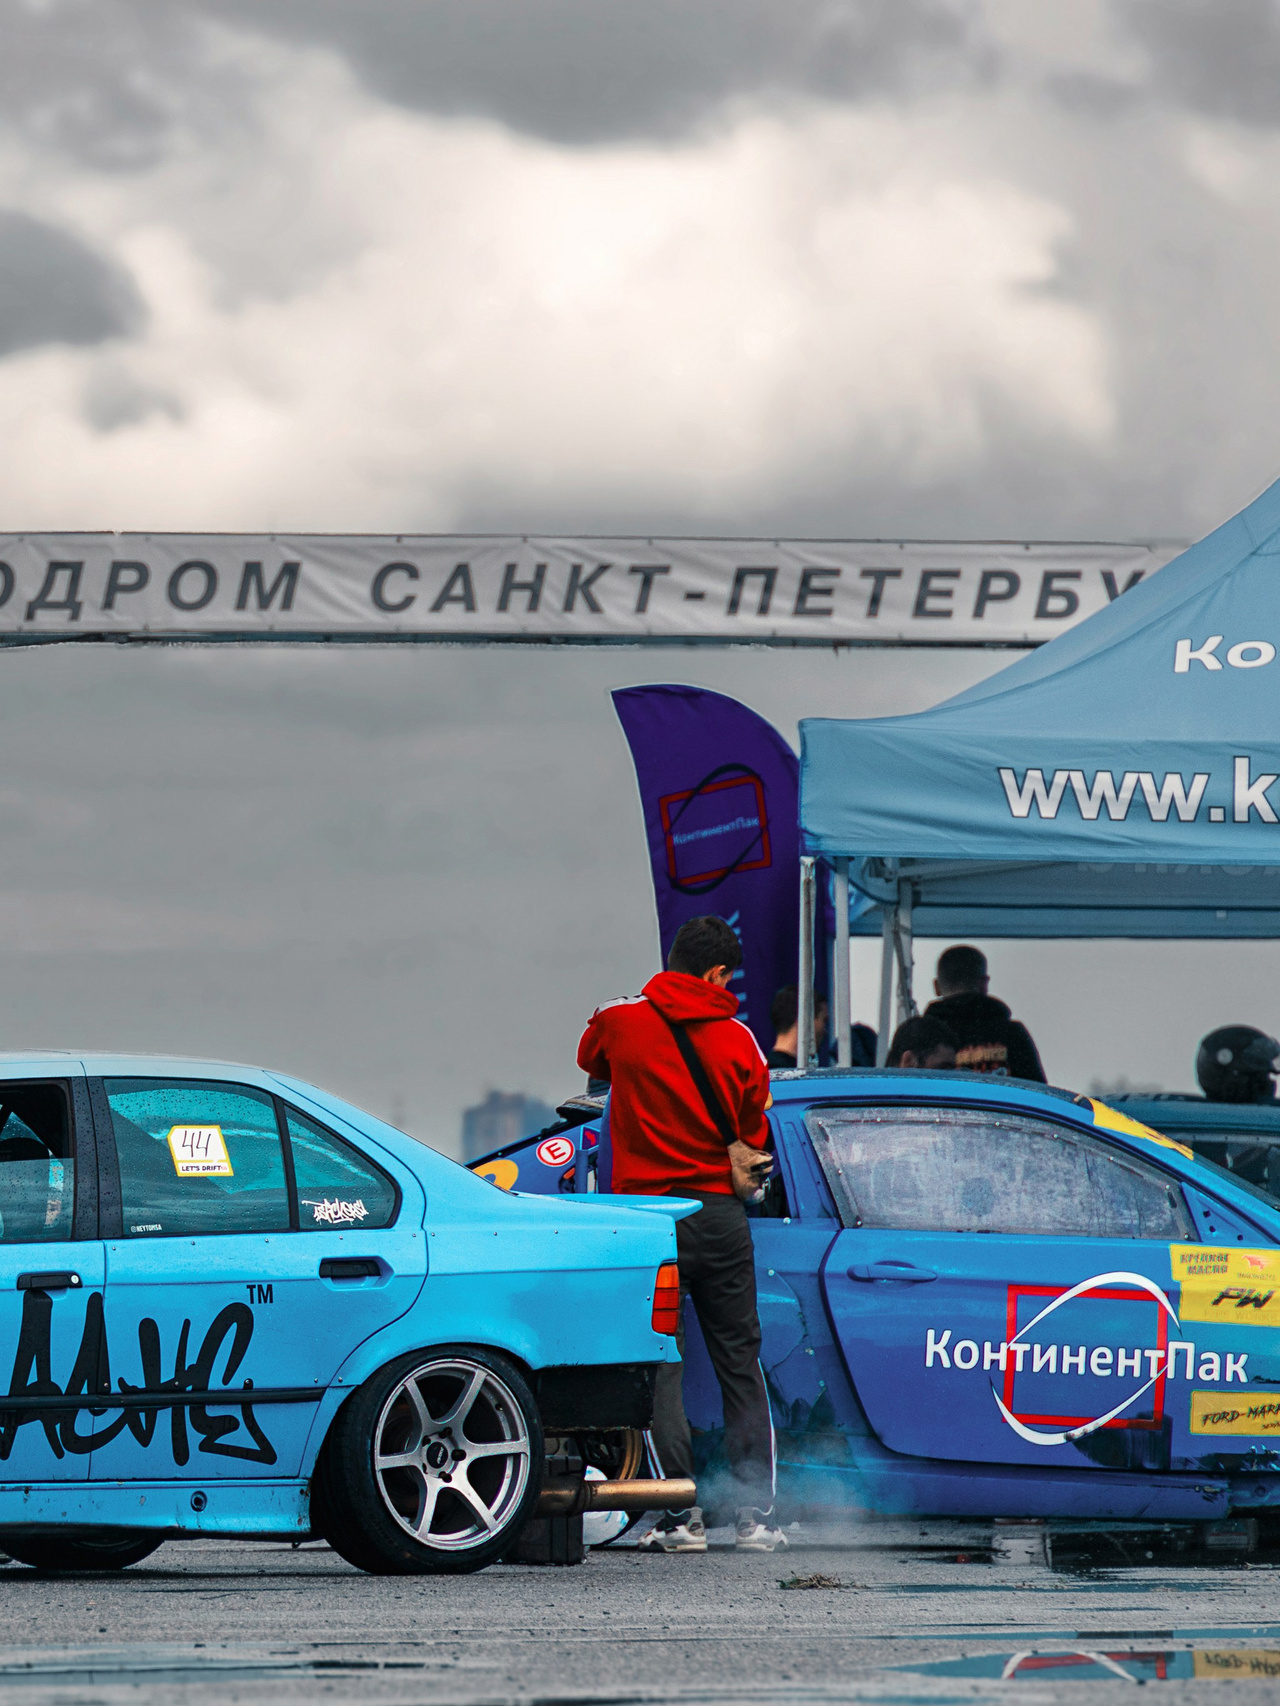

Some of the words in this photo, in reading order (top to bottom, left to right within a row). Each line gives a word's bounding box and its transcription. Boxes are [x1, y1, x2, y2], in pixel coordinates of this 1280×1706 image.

[181, 1130, 212, 1158] 44
[545, 1142, 567, 1160] E
[924, 1329, 1249, 1384] КонтинентПак
